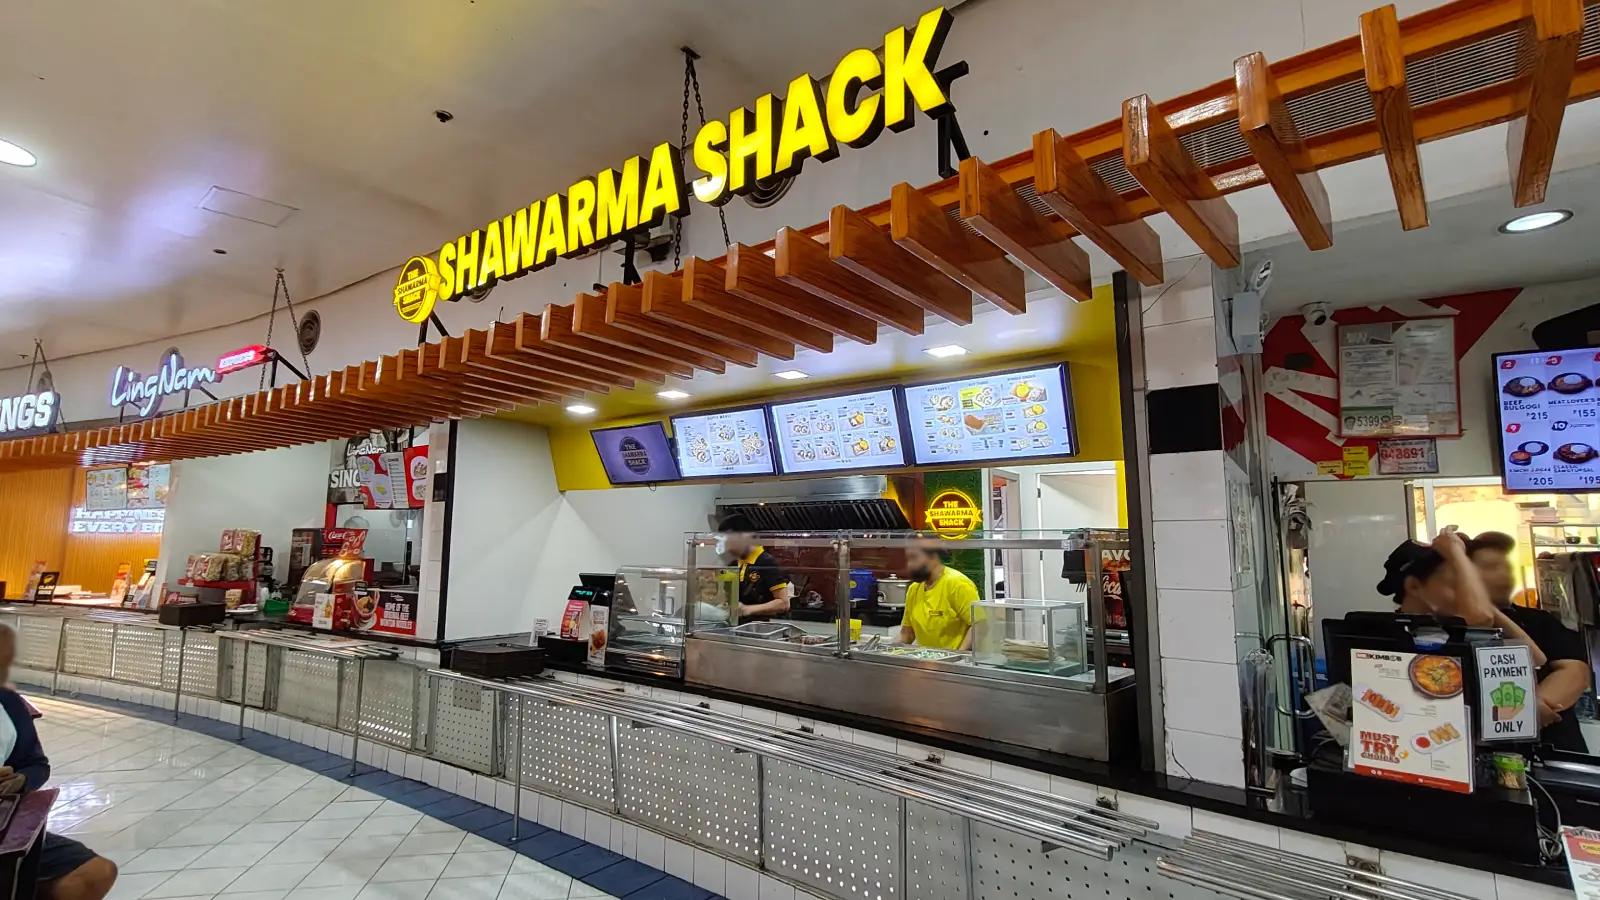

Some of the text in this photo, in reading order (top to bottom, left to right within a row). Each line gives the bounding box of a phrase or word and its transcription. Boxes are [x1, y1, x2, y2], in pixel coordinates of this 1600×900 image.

[439, 6, 947, 301] SHAWARMA SHACK
[397, 276, 427, 295] SHAWARMA
[111, 353, 216, 417] LingNam
[0, 391, 55, 433] NGS
[1504, 403, 1540, 411] BULGOGI
[942, 500, 959, 508] THE
[72, 521, 138, 533] EVERY
[1490, 653, 1516, 666] CASH
[1484, 666, 1528, 679] PAYMENT
[1494, 721, 1523, 733] ONLY
[1360, 731, 1399, 745] MUST
[1361, 740, 1400, 757] TRY
[1361, 751, 1400, 764] CHOICES
